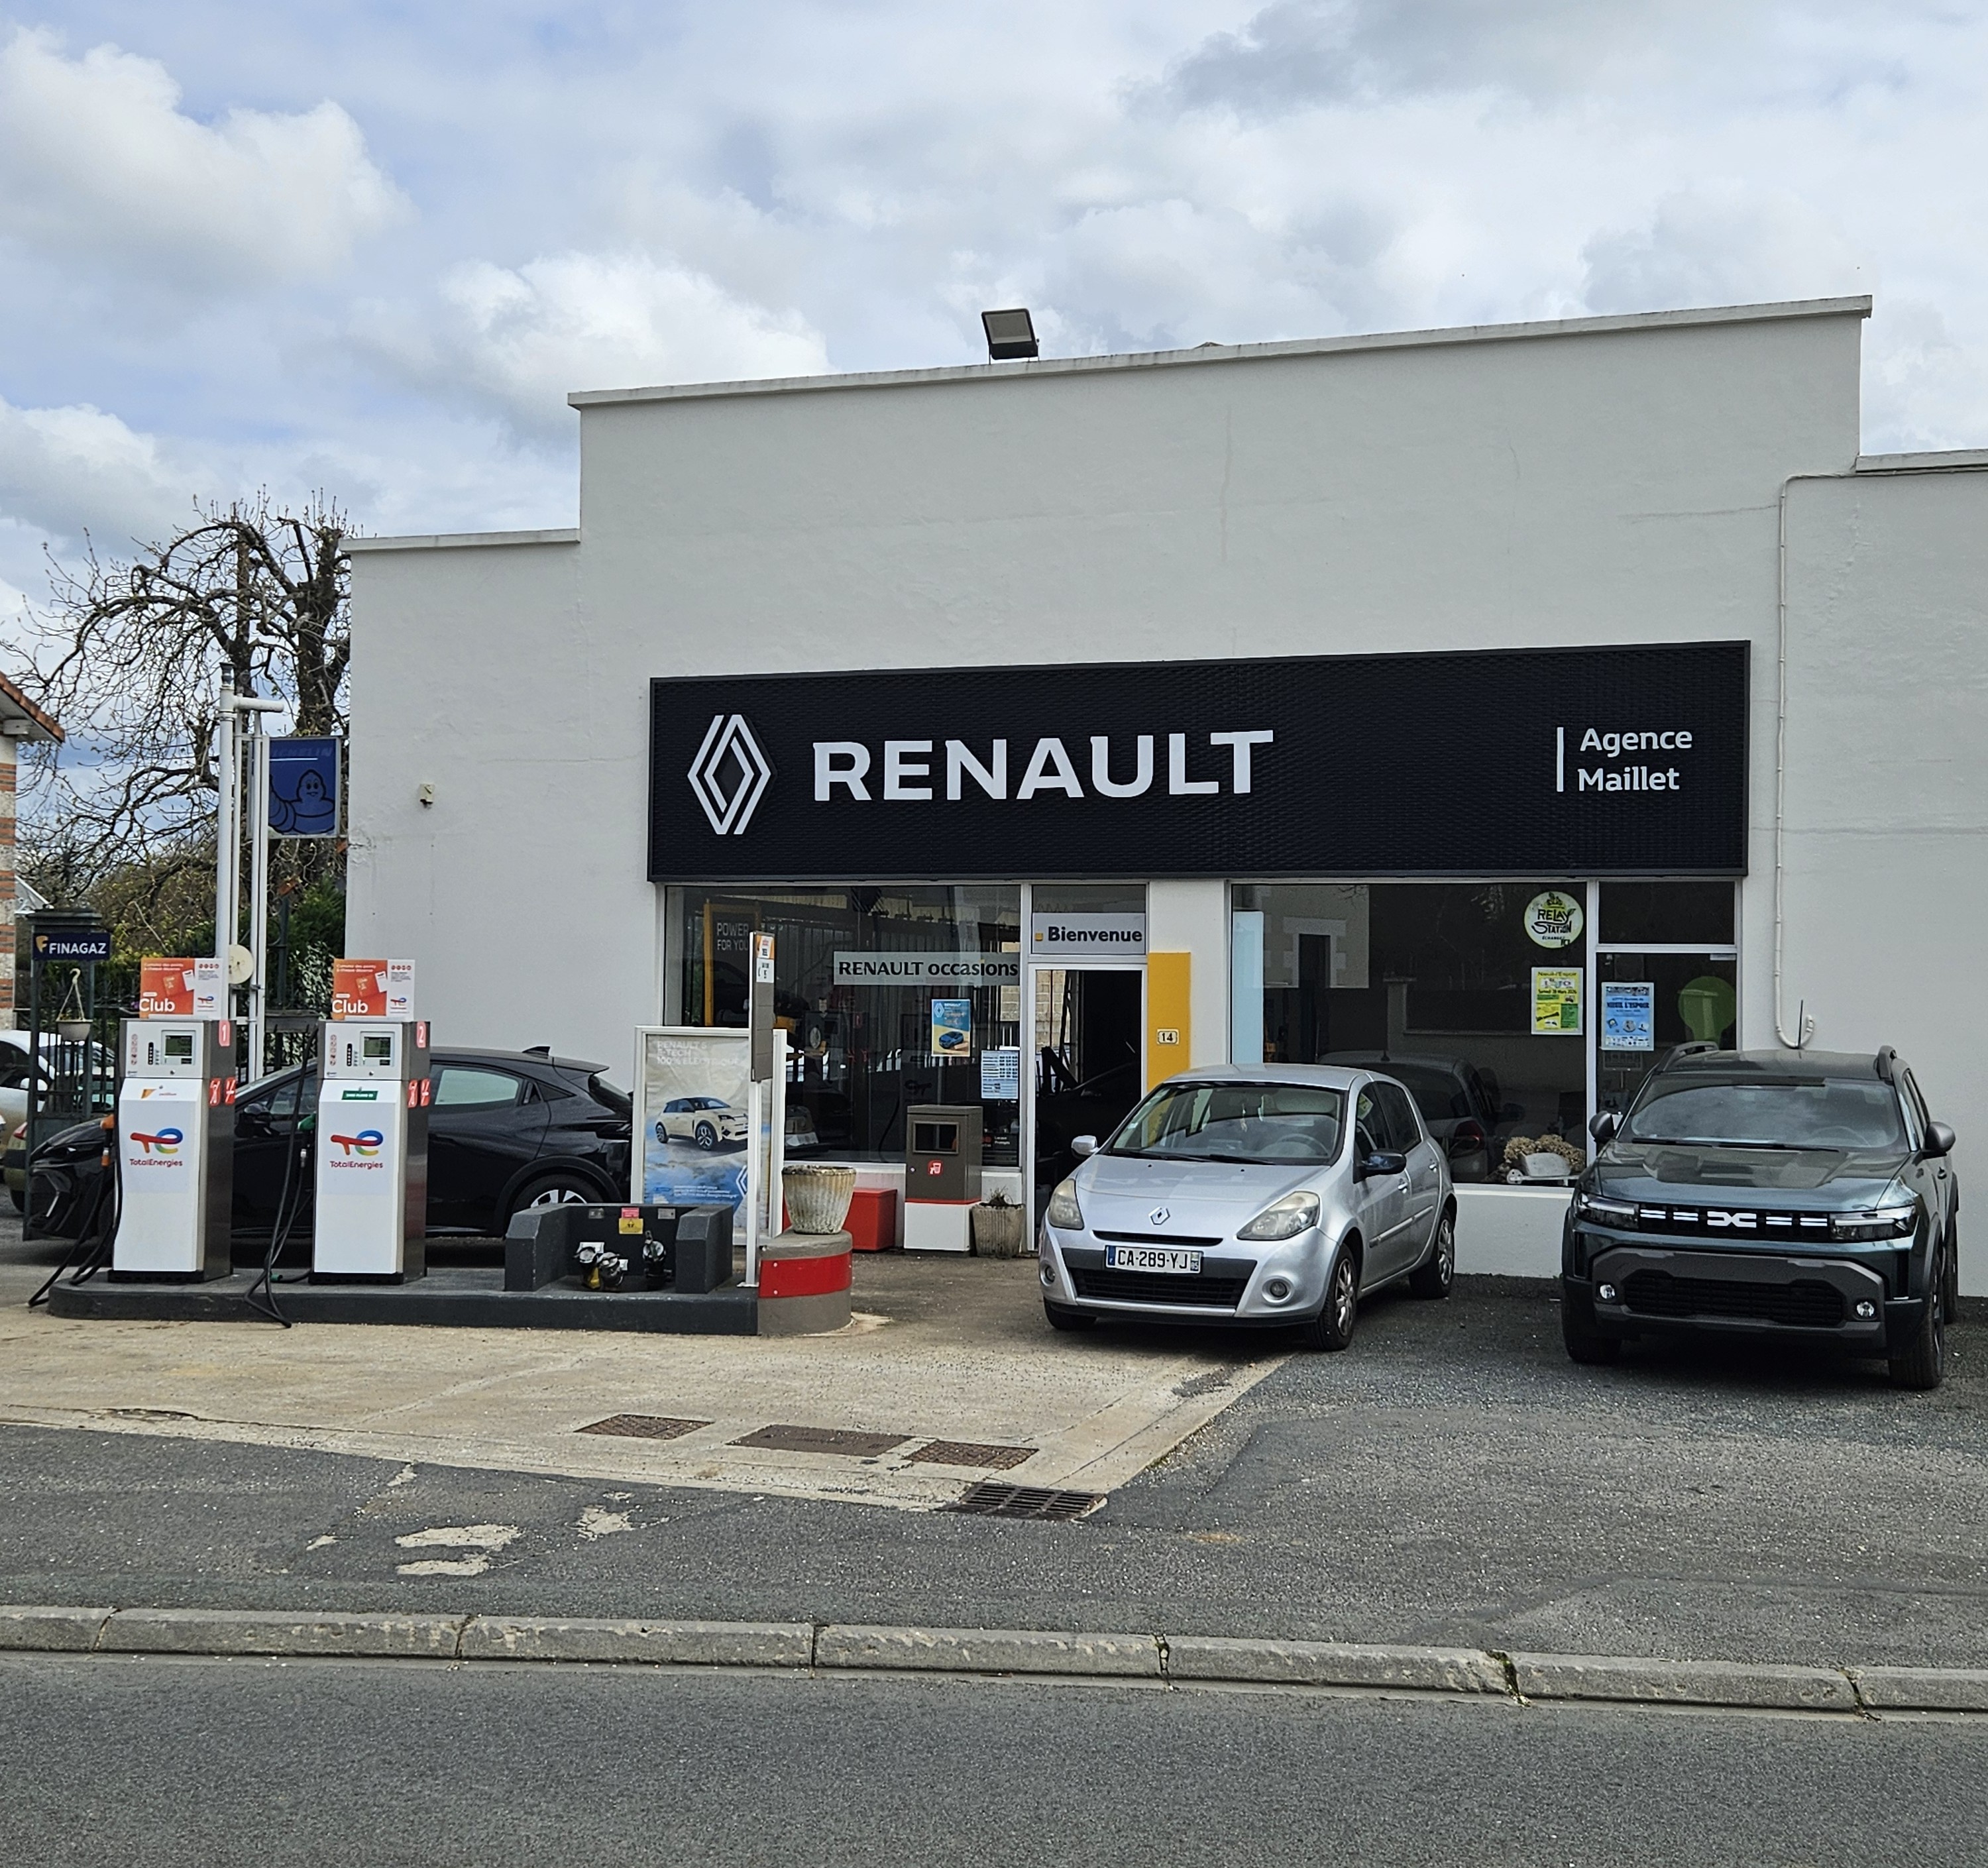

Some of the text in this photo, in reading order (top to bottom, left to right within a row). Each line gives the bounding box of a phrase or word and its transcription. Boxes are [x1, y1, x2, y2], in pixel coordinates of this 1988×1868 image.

[1580, 728, 1692, 758] Agence
[812, 730, 1274, 801] RENAULT
[1577, 766, 1681, 792] Maillet
[716, 922, 749, 936] POWER
[1048, 926, 1142, 942] Bienvenue
[49, 942, 107, 954] FINAGAZ
[717, 940, 732, 951] FOR
[838, 960, 1019, 976] RENAULT occasions
[139, 998, 175, 1012] Club
[332, 999, 368, 1013] Club
[222, 1024, 227, 1042] 1
[419, 1026, 424, 1043] 2
[1162, 1032, 1173, 1041] 14
[657, 1040, 700, 1049] RENAULT
[129, 1158, 183, 1168] TotalEnergies
[329, 1160, 384, 1170] TotalEnergies
[1118, 1250, 1188, 1269] CA-289-YJ
